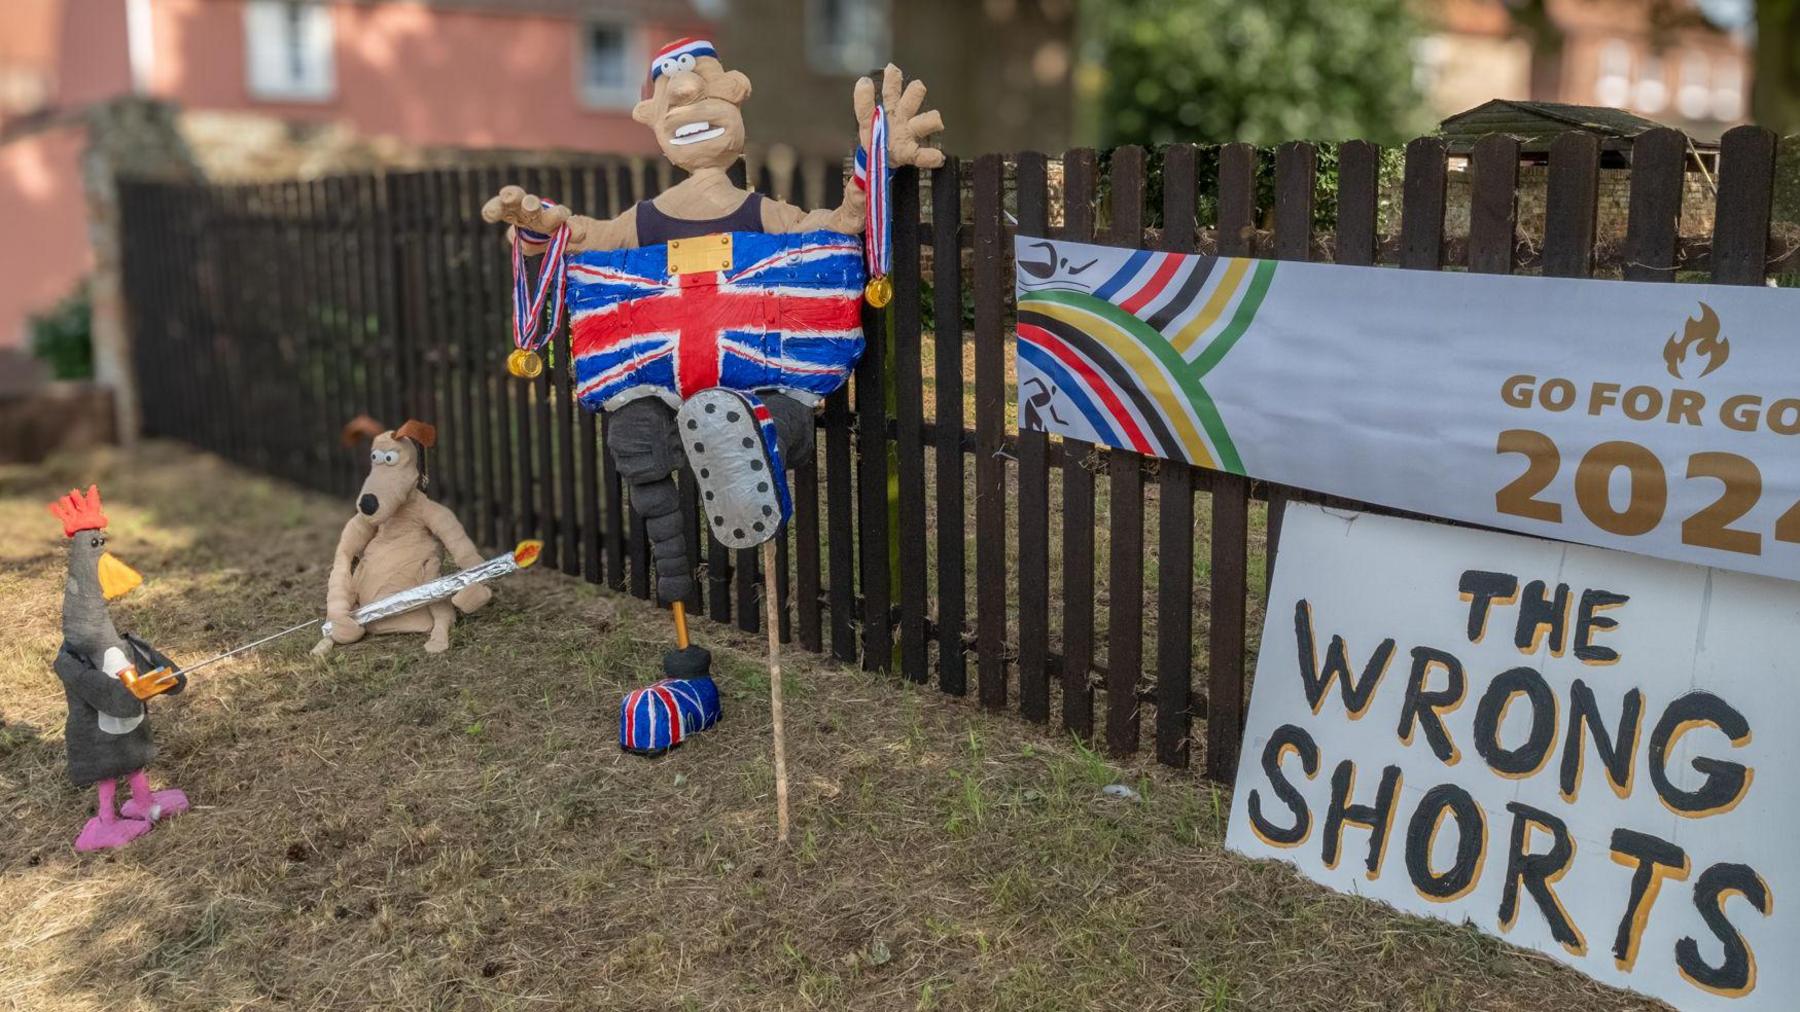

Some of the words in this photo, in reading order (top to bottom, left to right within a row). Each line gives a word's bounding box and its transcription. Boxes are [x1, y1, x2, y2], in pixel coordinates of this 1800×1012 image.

[1501, 374, 1576, 412] GO
[1588, 382, 1706, 426] FOR
[1459, 570, 1630, 665] THE
[1295, 598, 1754, 818] WRONG
[1248, 724, 1773, 997] SHORTS
